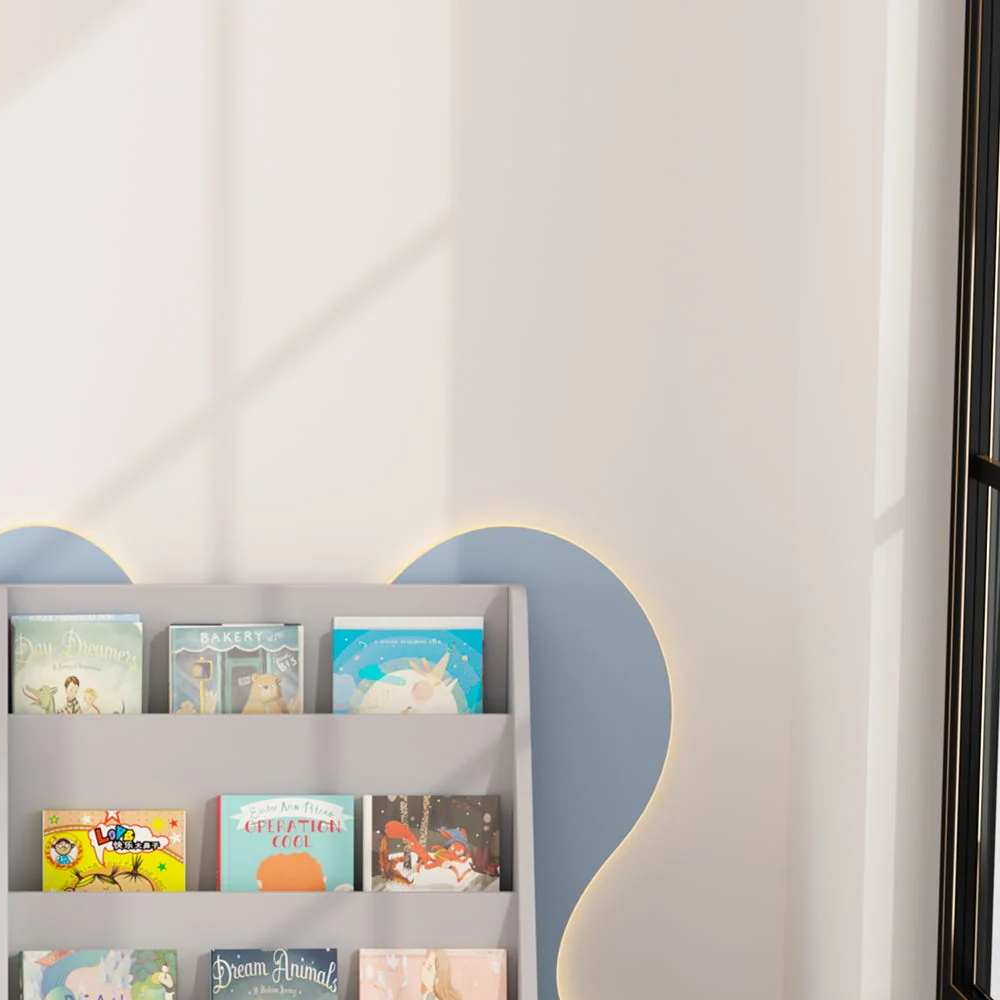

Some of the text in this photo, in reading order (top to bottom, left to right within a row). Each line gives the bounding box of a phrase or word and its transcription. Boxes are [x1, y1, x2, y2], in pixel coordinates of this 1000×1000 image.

[200, 631, 263, 644] BAKERY
[15, 627, 138, 669] Day Dreamers
[244, 819, 342, 834] OPERATION
[111, 840, 161, 851] 快乐大鼻子
[271, 834, 313, 849] COOL
[212, 947, 338, 994] Dream Animals
